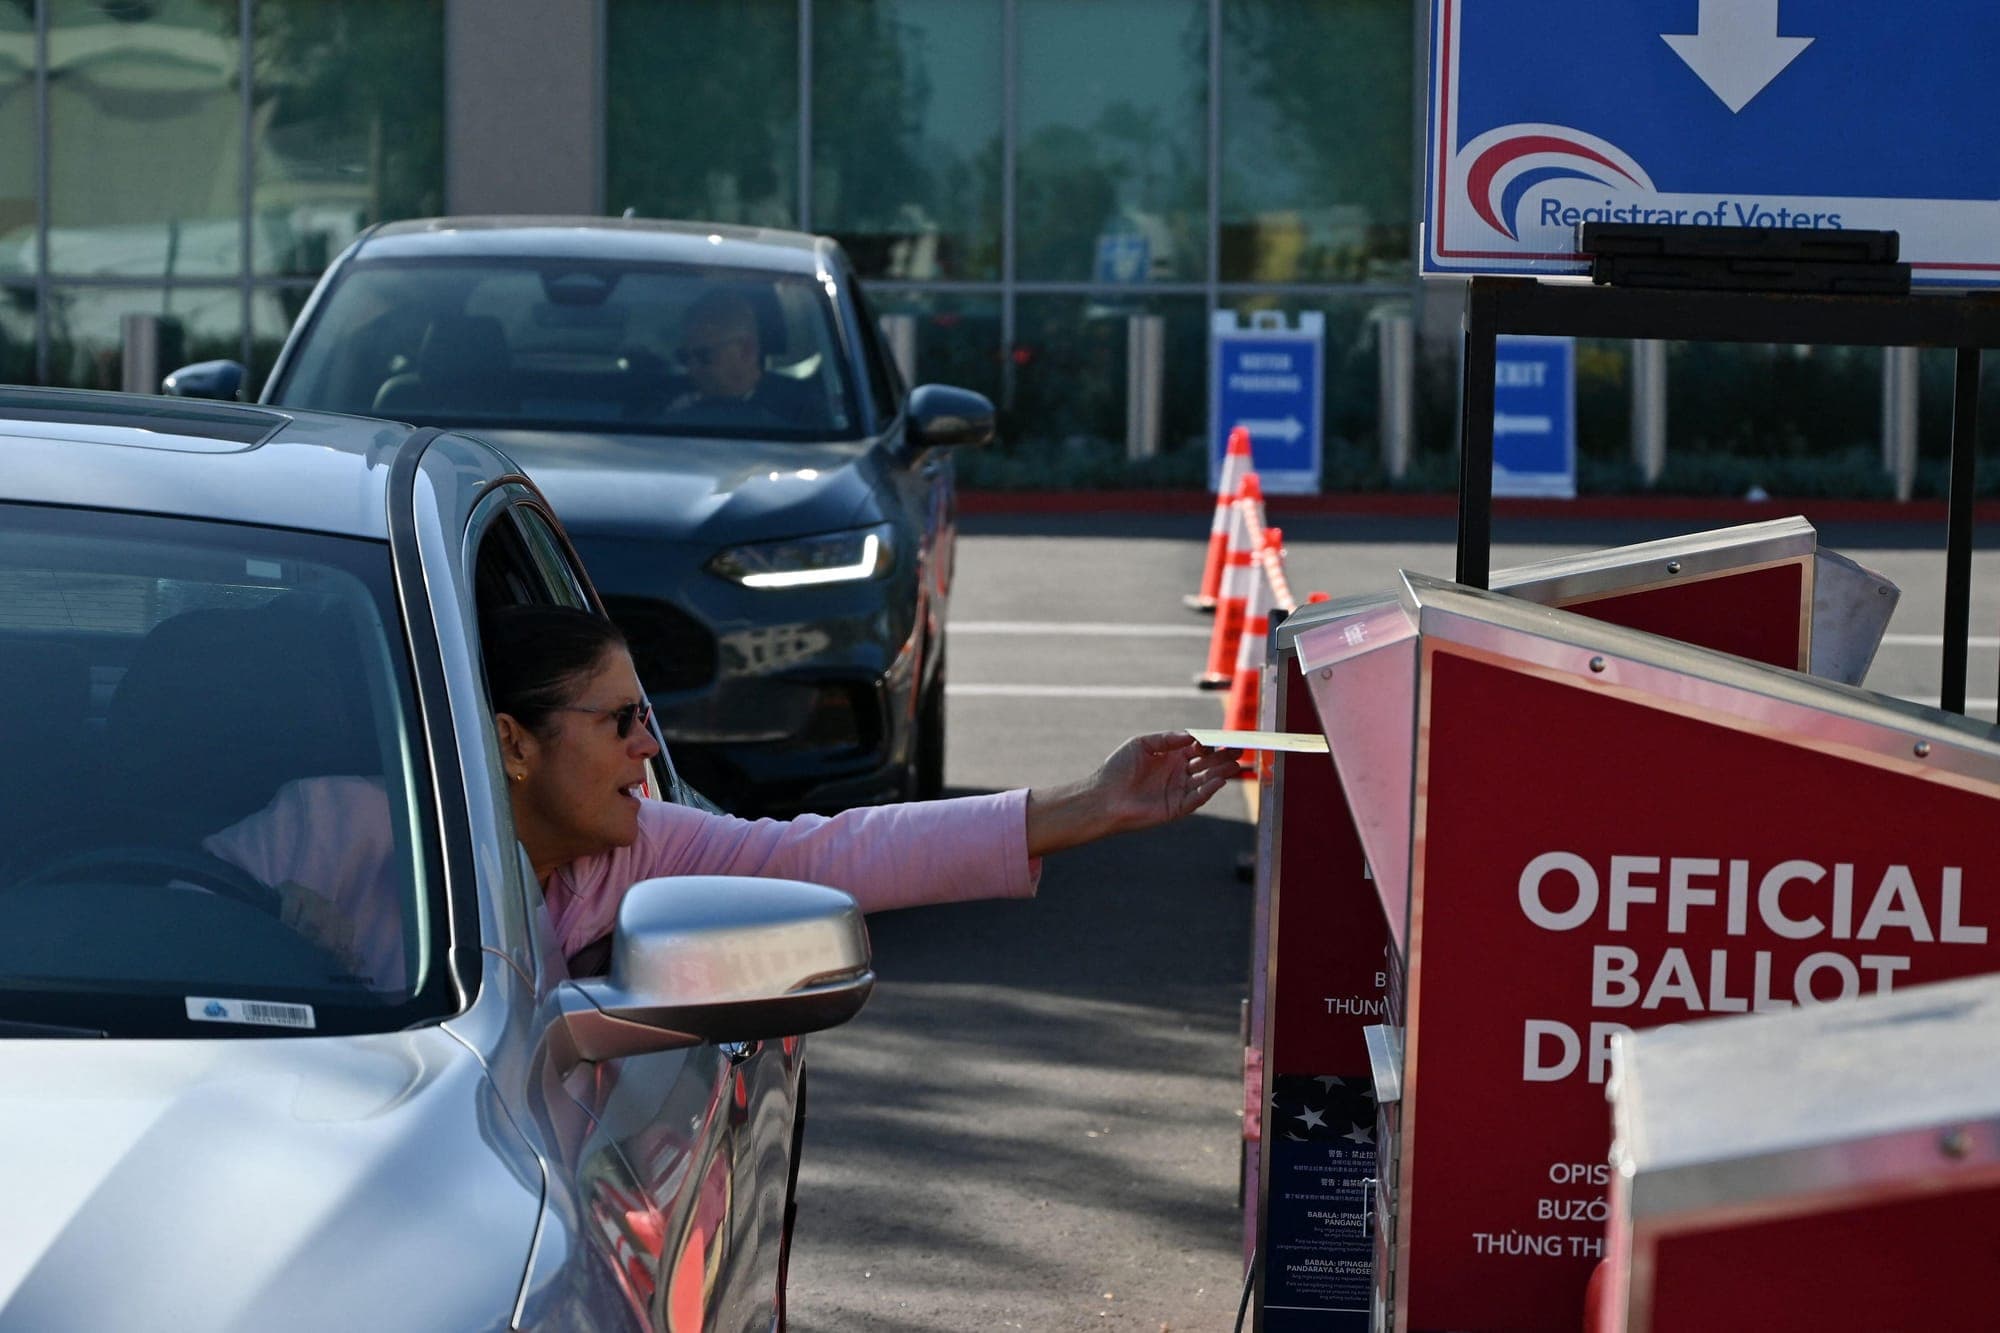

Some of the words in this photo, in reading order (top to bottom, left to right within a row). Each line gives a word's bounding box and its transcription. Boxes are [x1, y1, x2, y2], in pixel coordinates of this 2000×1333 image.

[1540, 198, 1688, 227] Registrar
[1693, 201, 1729, 227] of
[1734, 202, 1843, 230] Voters
[1518, 851, 1988, 944] OFFICIAL
[1591, 945, 1911, 1012] BALLOT
[1523, 1019, 1634, 1084] DR
[1549, 1163, 1610, 1185] OPIS
[1325, 1219, 1364, 1227] PANGANG
[1537, 1196, 1610, 1222] BUZÓ
[1472, 1228, 1562, 1257] THÙNG
[1567, 1236, 1605, 1258] TH
[1286, 1265, 1333, 1274] PANDARAYA
[1334, 1266, 1344, 1274] SA
[1346, 1267, 1371, 1275] PROSE
[1338, 1260, 1372, 1268] IPINAGBA
